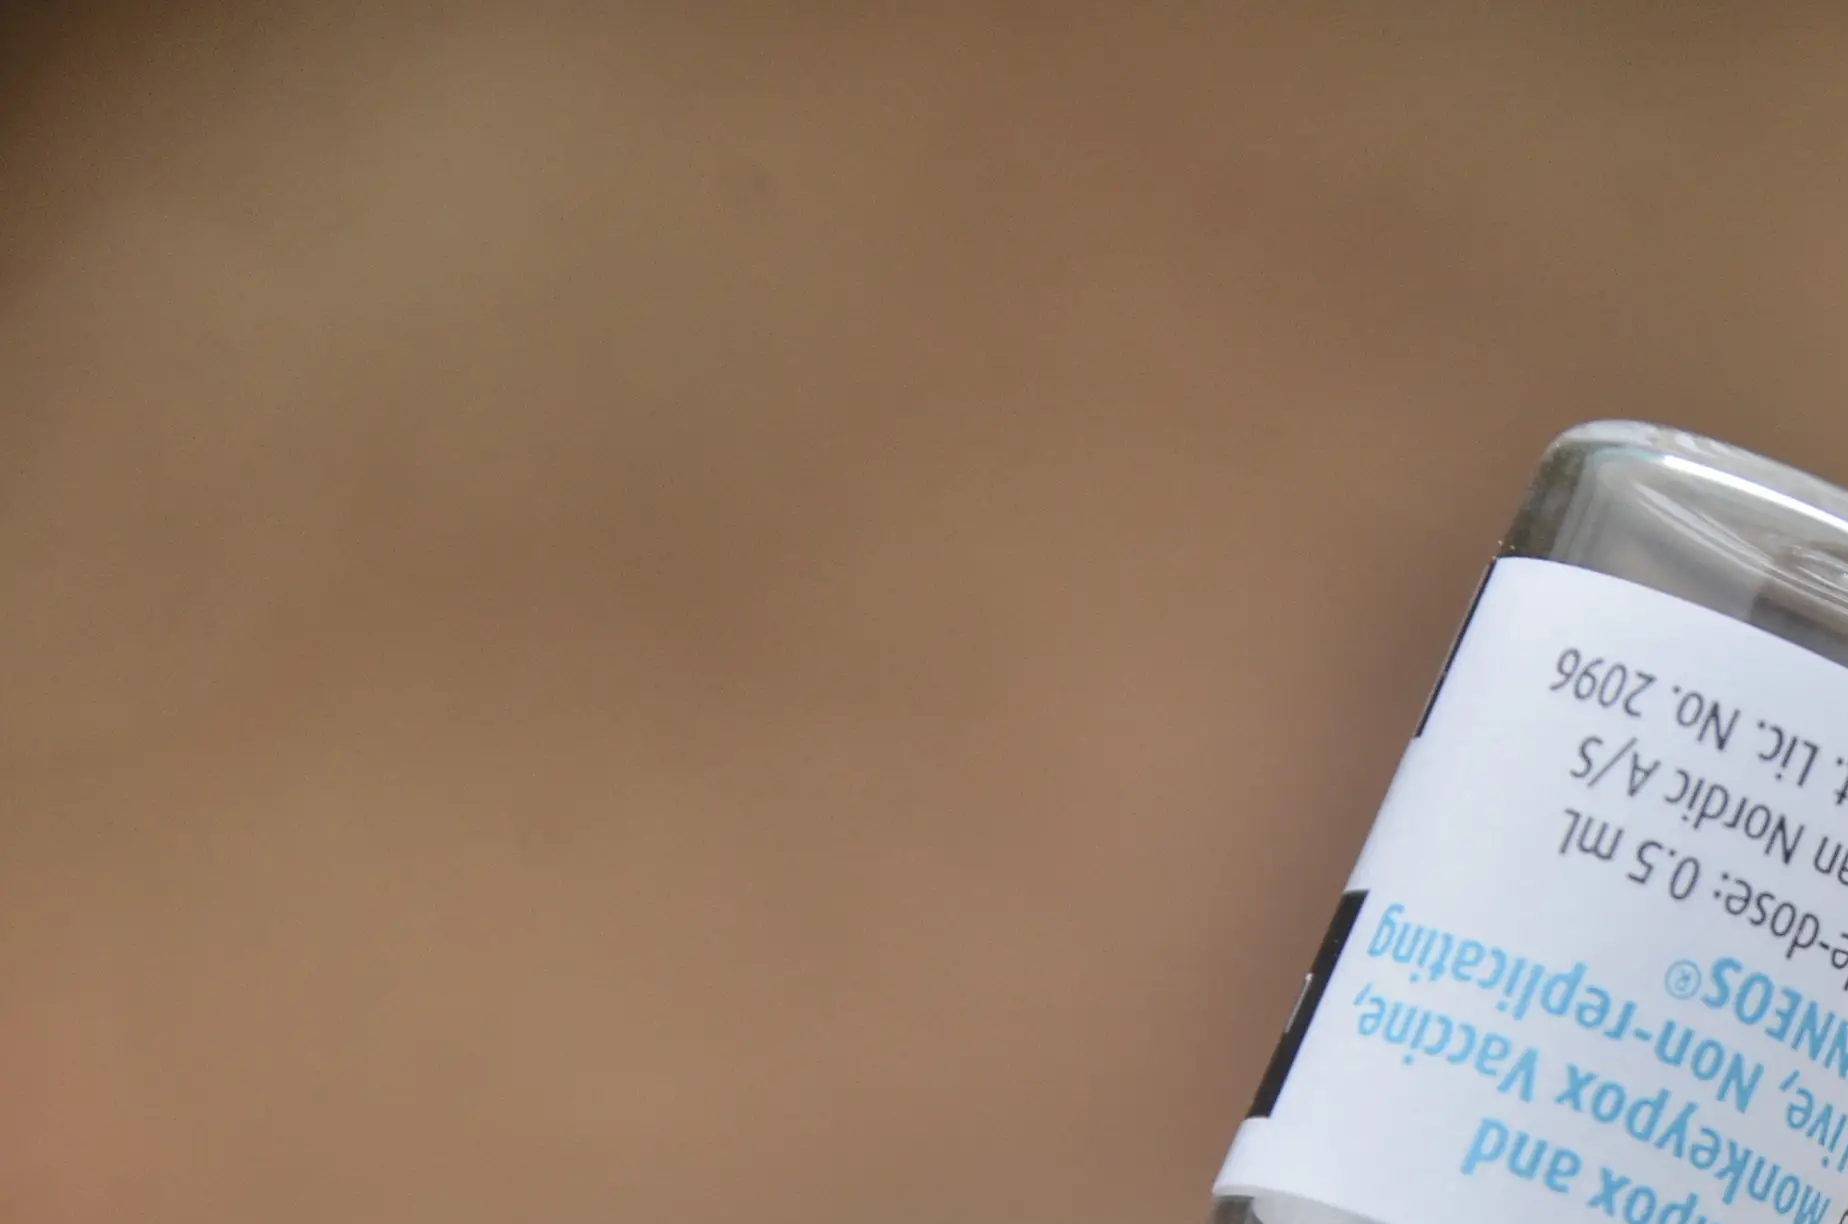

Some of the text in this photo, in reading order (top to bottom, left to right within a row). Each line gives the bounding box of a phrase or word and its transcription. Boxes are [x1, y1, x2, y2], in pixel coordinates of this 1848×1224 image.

[1549, 647, 1658, 718] 2096
[1672, 685, 1742, 752] No.
[1756, 719, 1821, 788] Lic.
[1569, 735, 1662, 798] A/S
[1558, 808, 1625, 862] mL
[1664, 768, 1806, 866] Nordic
[1626, 839, 1701, 902] 0.5
[1352, 984, 1537, 1102] Vaccine,
[1366, 903, 1764, 1115] Non-replicating
[1461, 1118, 1582, 1194] and
